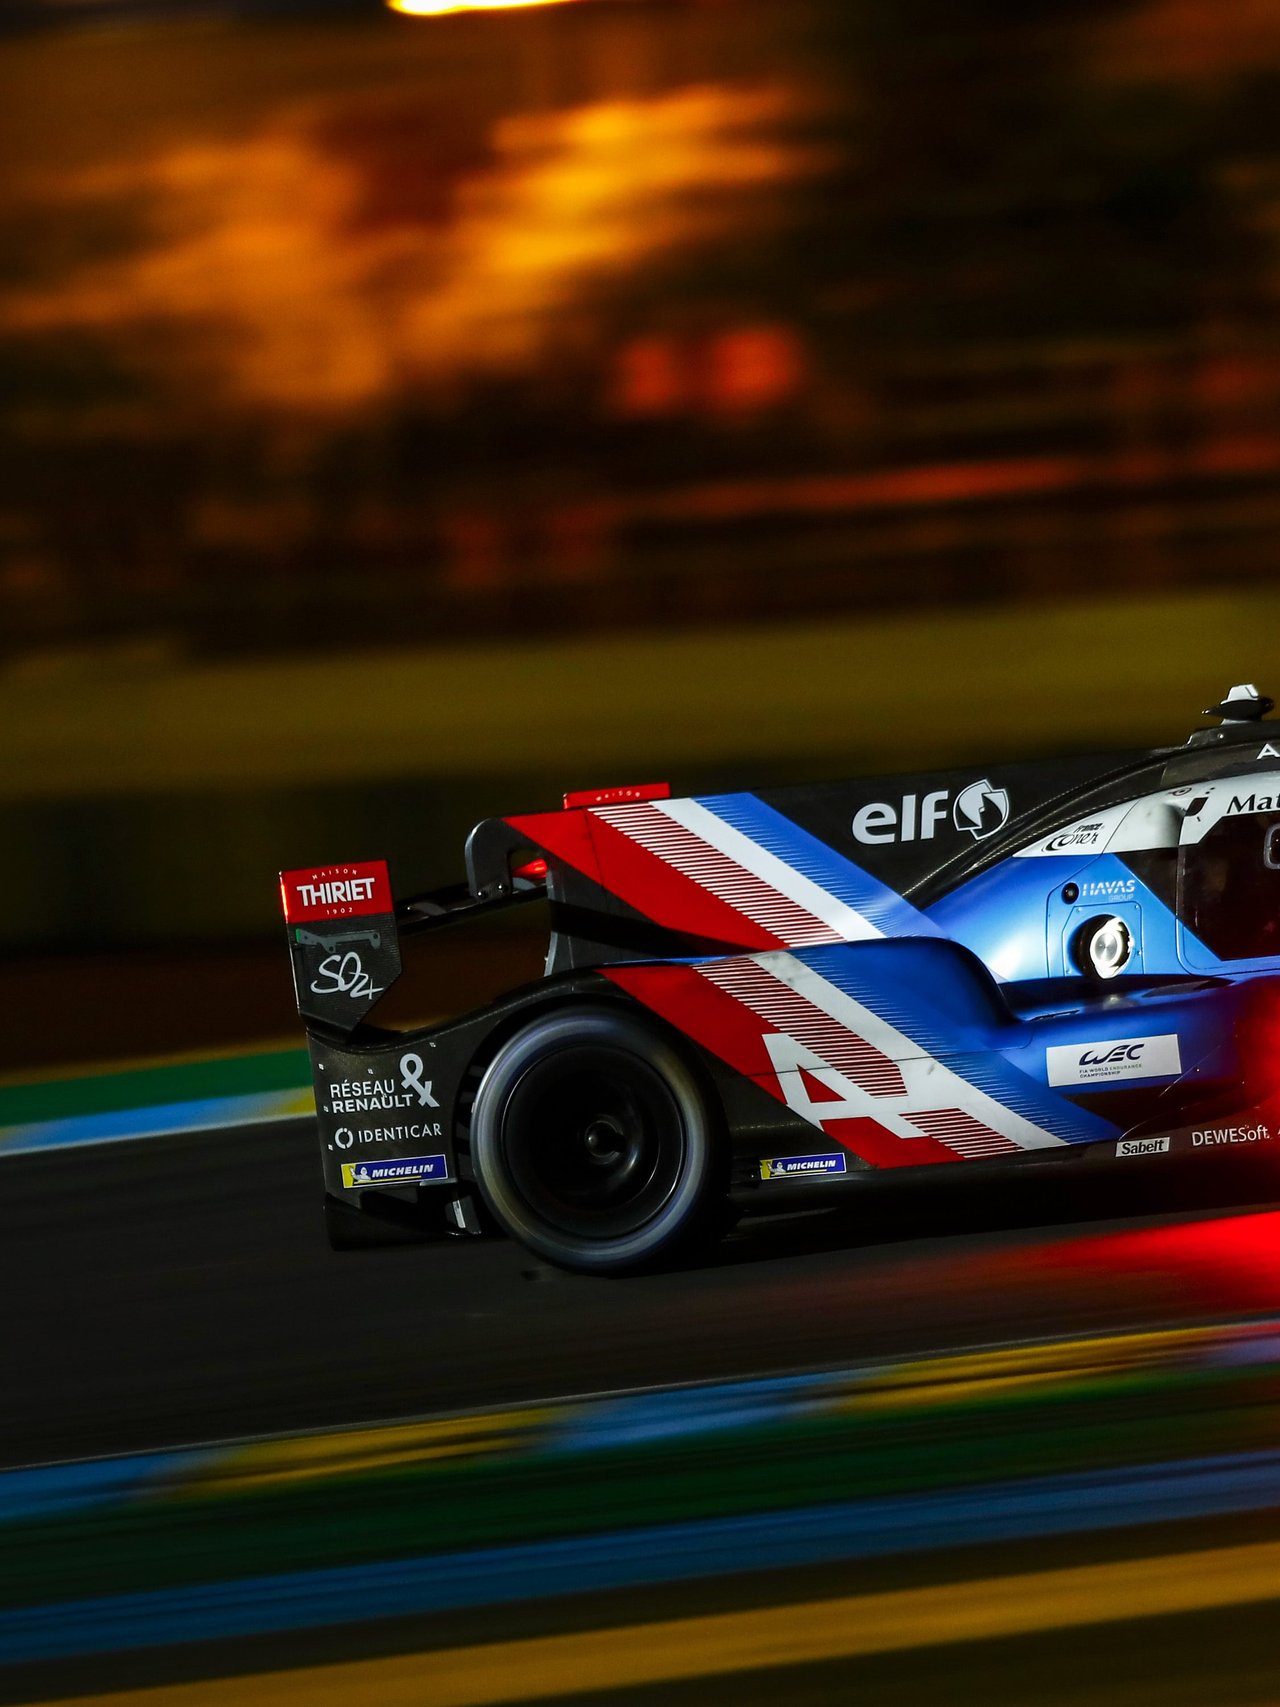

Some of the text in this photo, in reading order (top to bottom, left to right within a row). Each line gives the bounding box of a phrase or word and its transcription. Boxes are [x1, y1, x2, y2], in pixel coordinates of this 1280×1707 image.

[851, 790, 949, 845] elf
[296, 877, 376, 907] THIRIET
[1082, 879, 1136, 897] HAVAS
[326, 906, 353, 916] 1902
[1078, 1043, 1145, 1066] WEC
[330, 1078, 396, 1099] RÉSEAU
[332, 1093, 414, 1114] RENAULT
[358, 1123, 442, 1144] IDENTICAR
[1121, 1138, 1165, 1155] Sabelt
[371, 1163, 434, 1179] MICHELIN
[786, 1159, 836, 1172] MICHELIN
